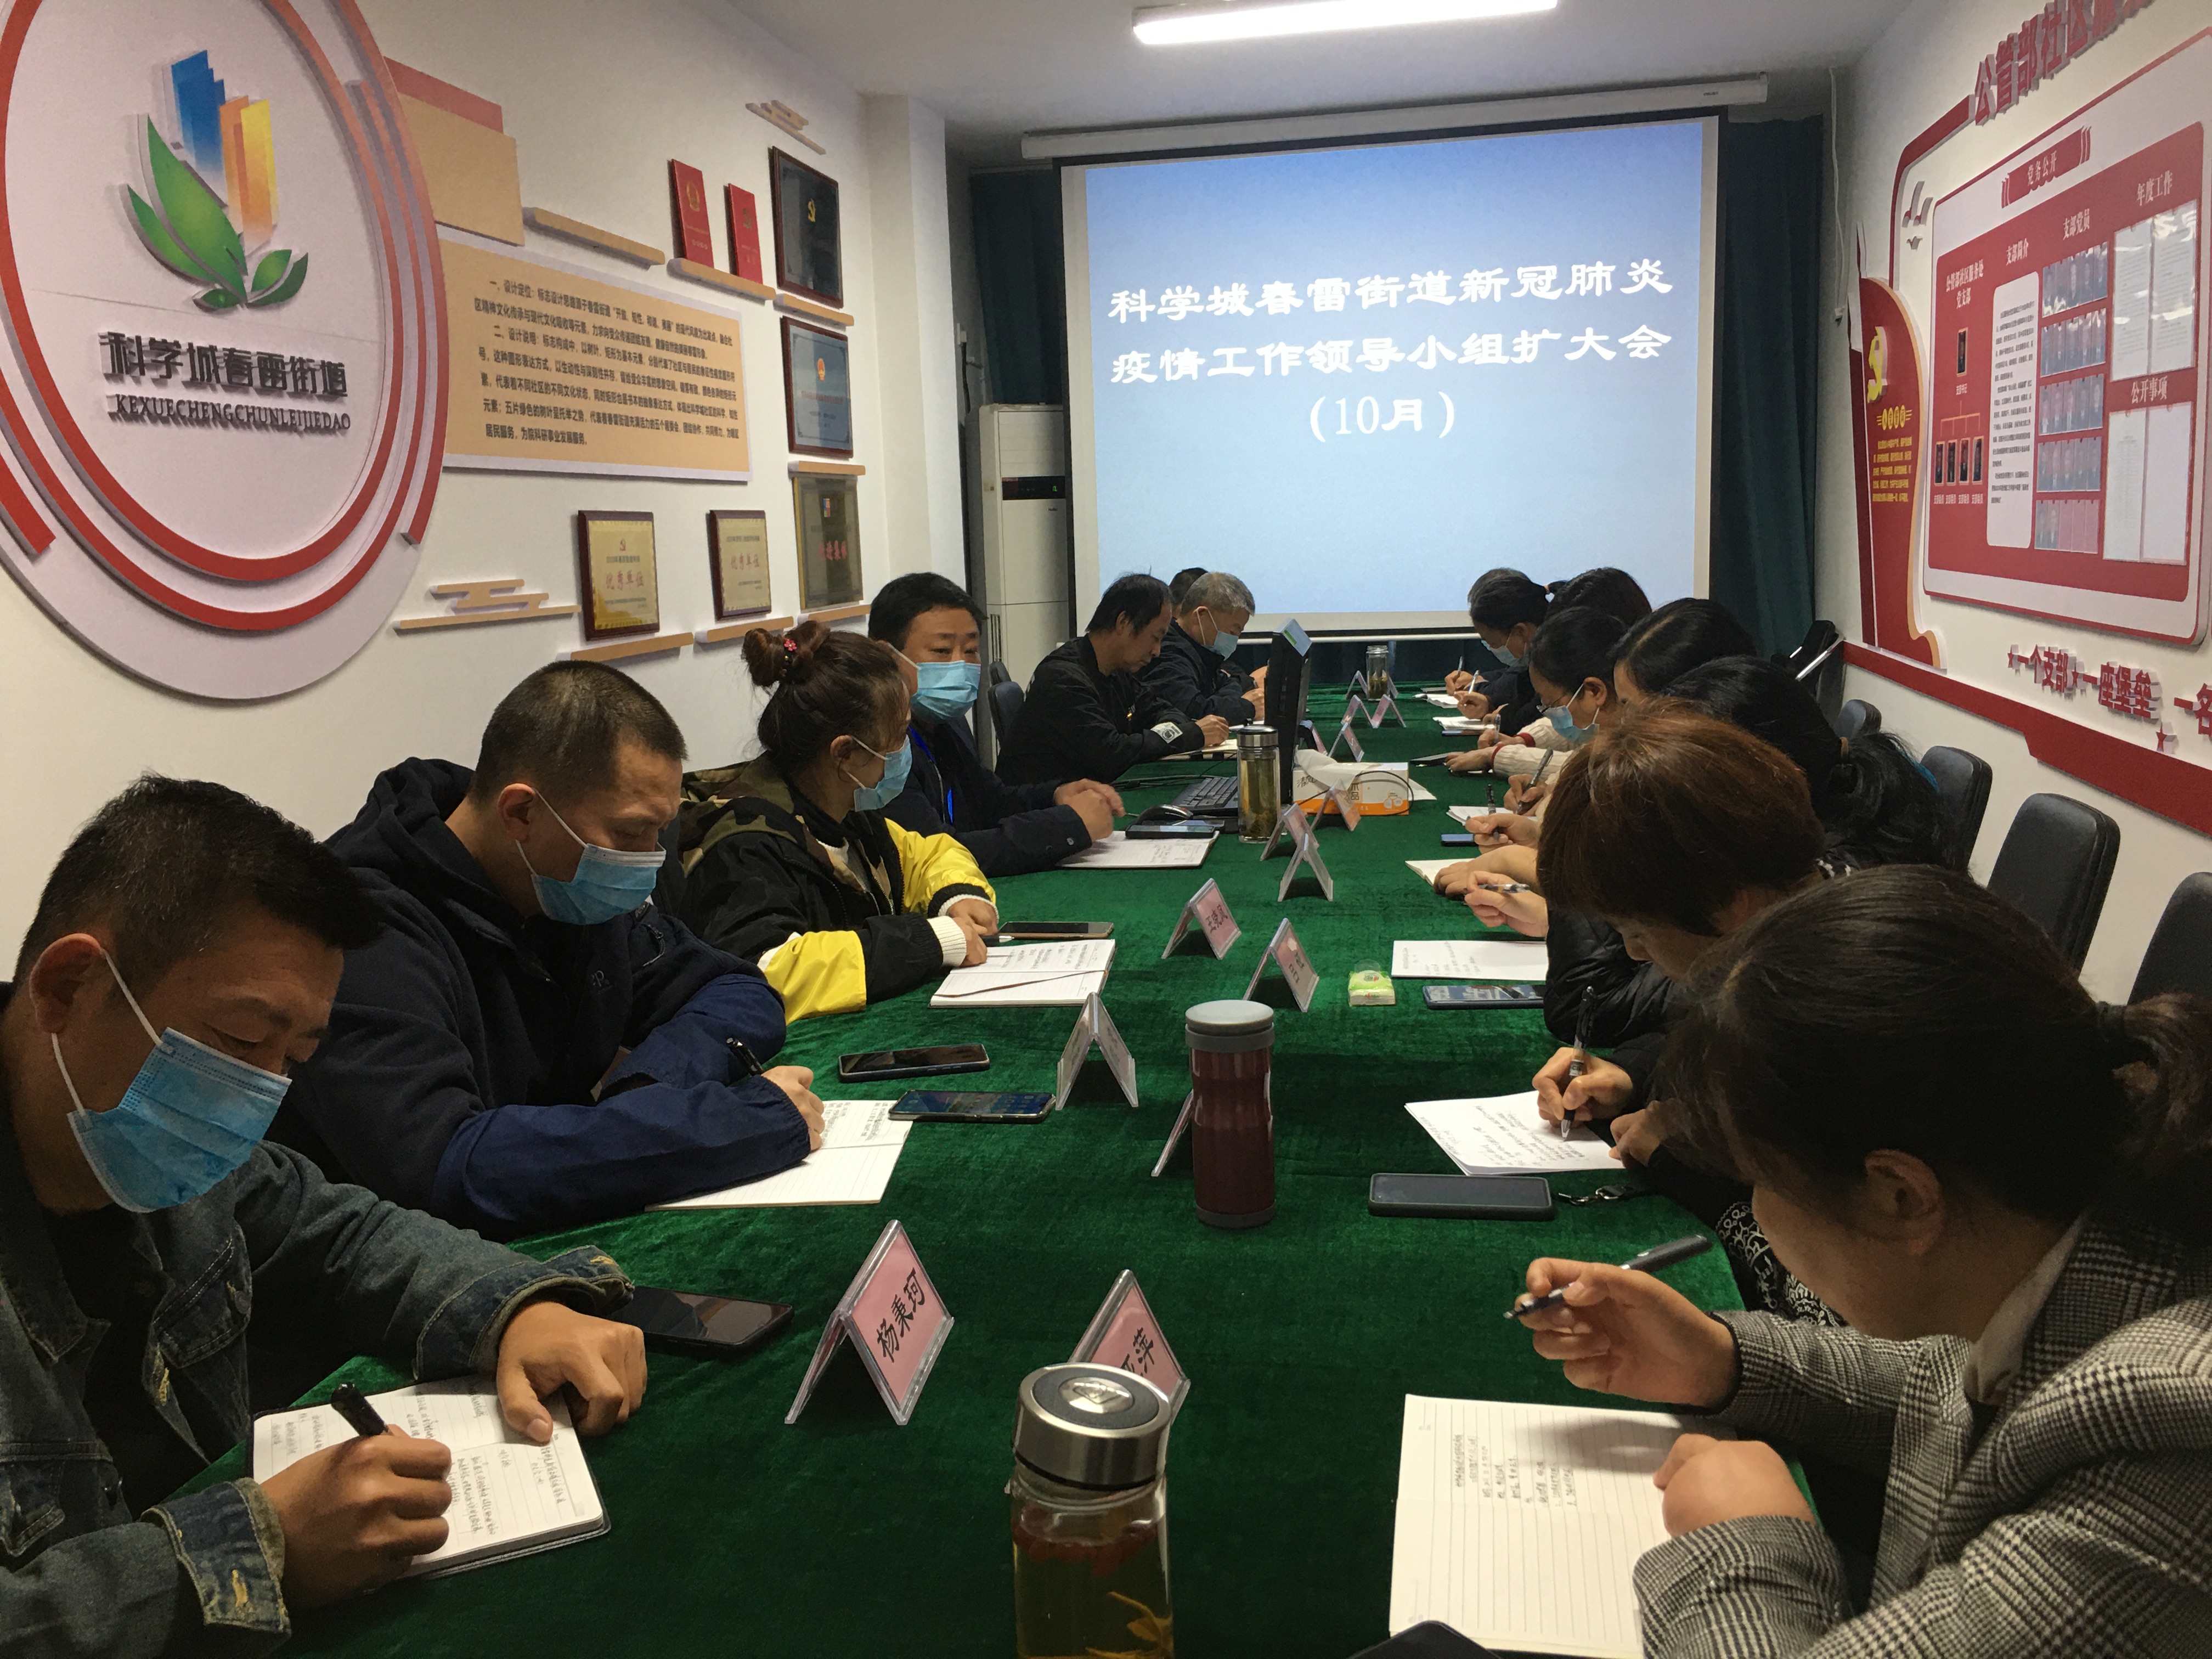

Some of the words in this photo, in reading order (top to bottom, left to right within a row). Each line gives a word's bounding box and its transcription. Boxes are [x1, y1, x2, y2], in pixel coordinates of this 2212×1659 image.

[1975, 0, 2146, 126] 公管部社区
[2027, 150, 2057, 185] 党务公开
[2136, 170, 2173, 206] 年度工作
[2063, 208, 2090, 240] 支部党员
[2006, 238, 2029, 266] 支部简介
[1108, 258, 1673, 324] 科学城春雷街道新冠肺炎
[1946, 259, 1984, 292] 公管部社区服务处
[1956, 289, 1971, 309] 党支部
[107, 330, 348, 398] 科学城春雷街道
[1110, 324, 1672, 384] 疫情工作领导小组扩大会
[2131, 376, 2168, 404] 公开事项
[115, 394, 351, 431] KEXUECHENGCHUNLEIJIEDAO
[605, 569, 645, 591] 优秀单位
[876, 1267, 926, 1363] 杨秉珂
